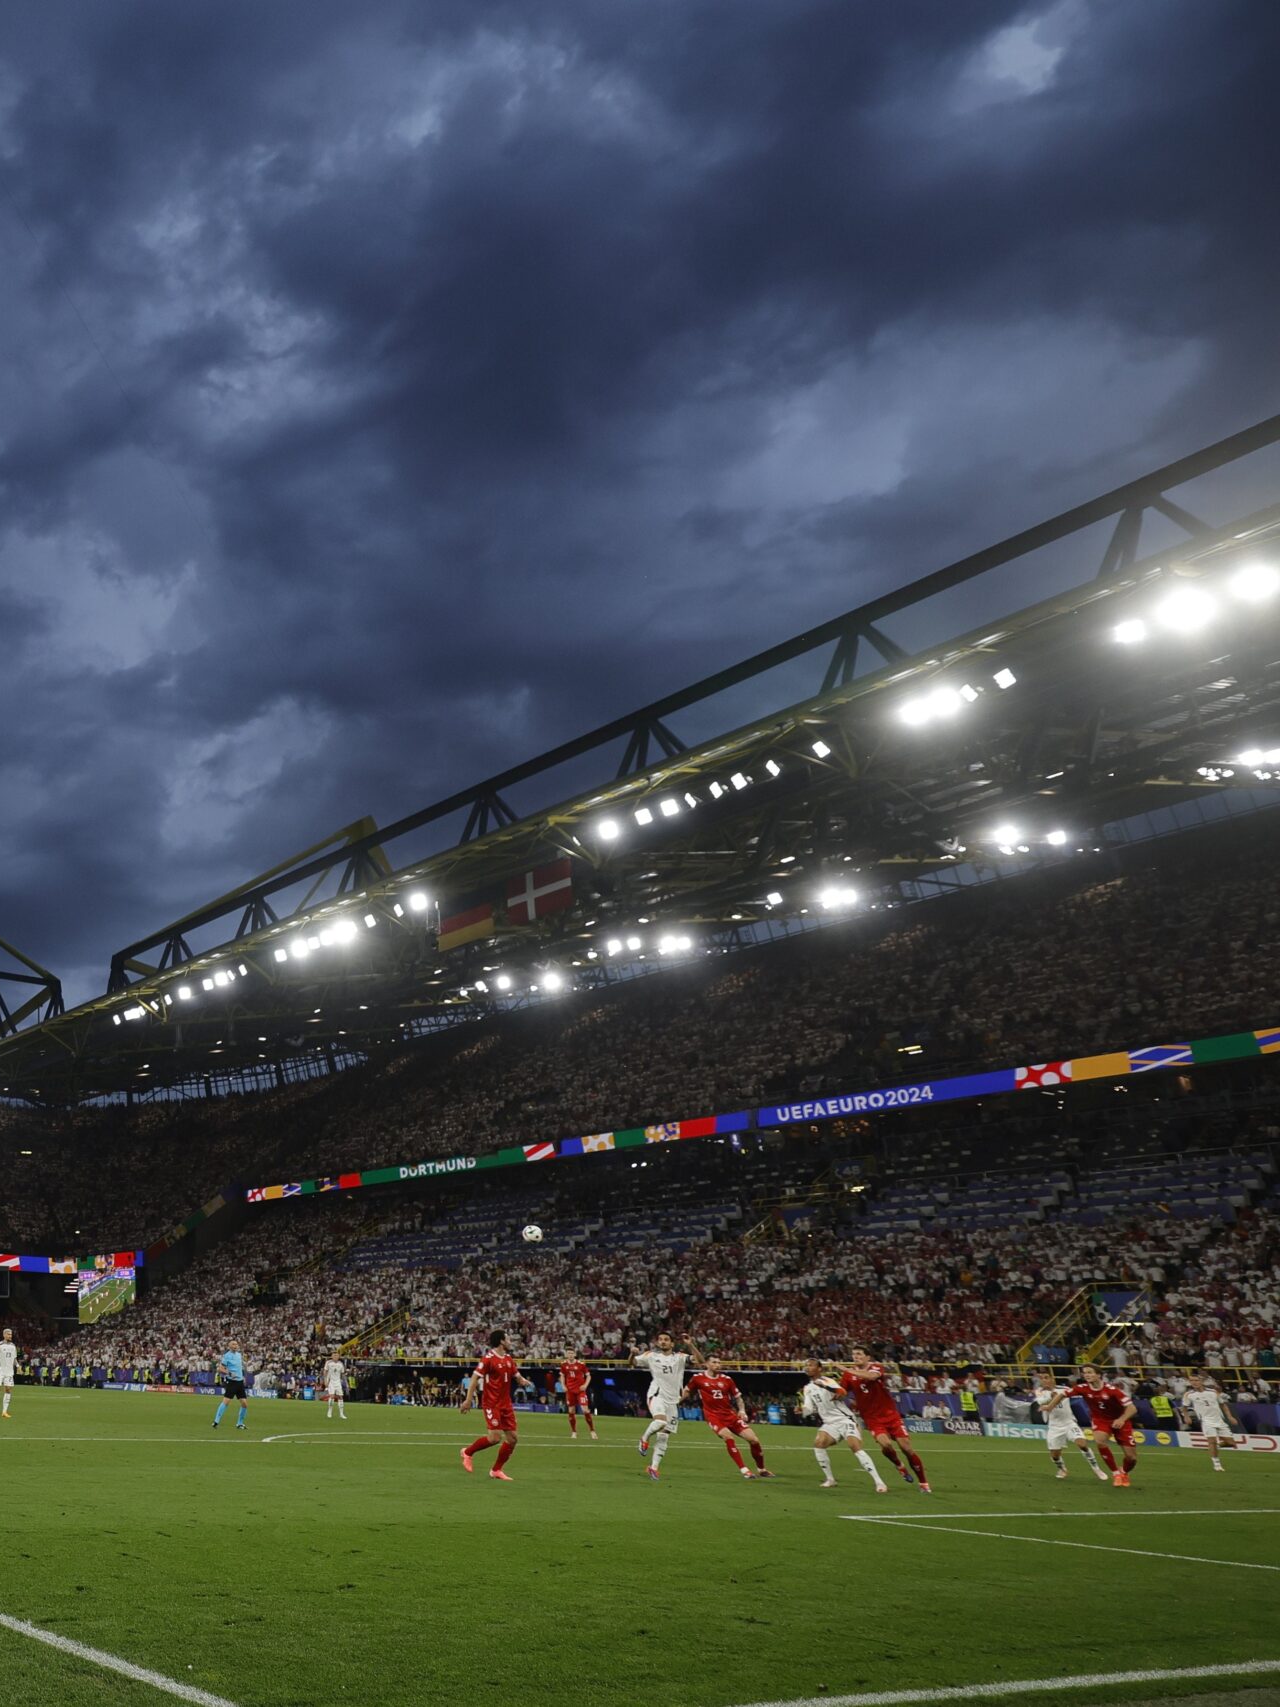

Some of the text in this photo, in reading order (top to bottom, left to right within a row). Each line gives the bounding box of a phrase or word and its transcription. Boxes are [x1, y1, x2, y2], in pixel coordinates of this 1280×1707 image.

[399, 1157, 477, 1179] DORTMUND
[662, 1365, 673, 1374] 21
[711, 1389, 724, 1400] 23
[908, 1425, 934, 1433] QATAR
[944, 1420, 981, 1432] QATAR
[986, 1422, 1048, 1440] Hisen
